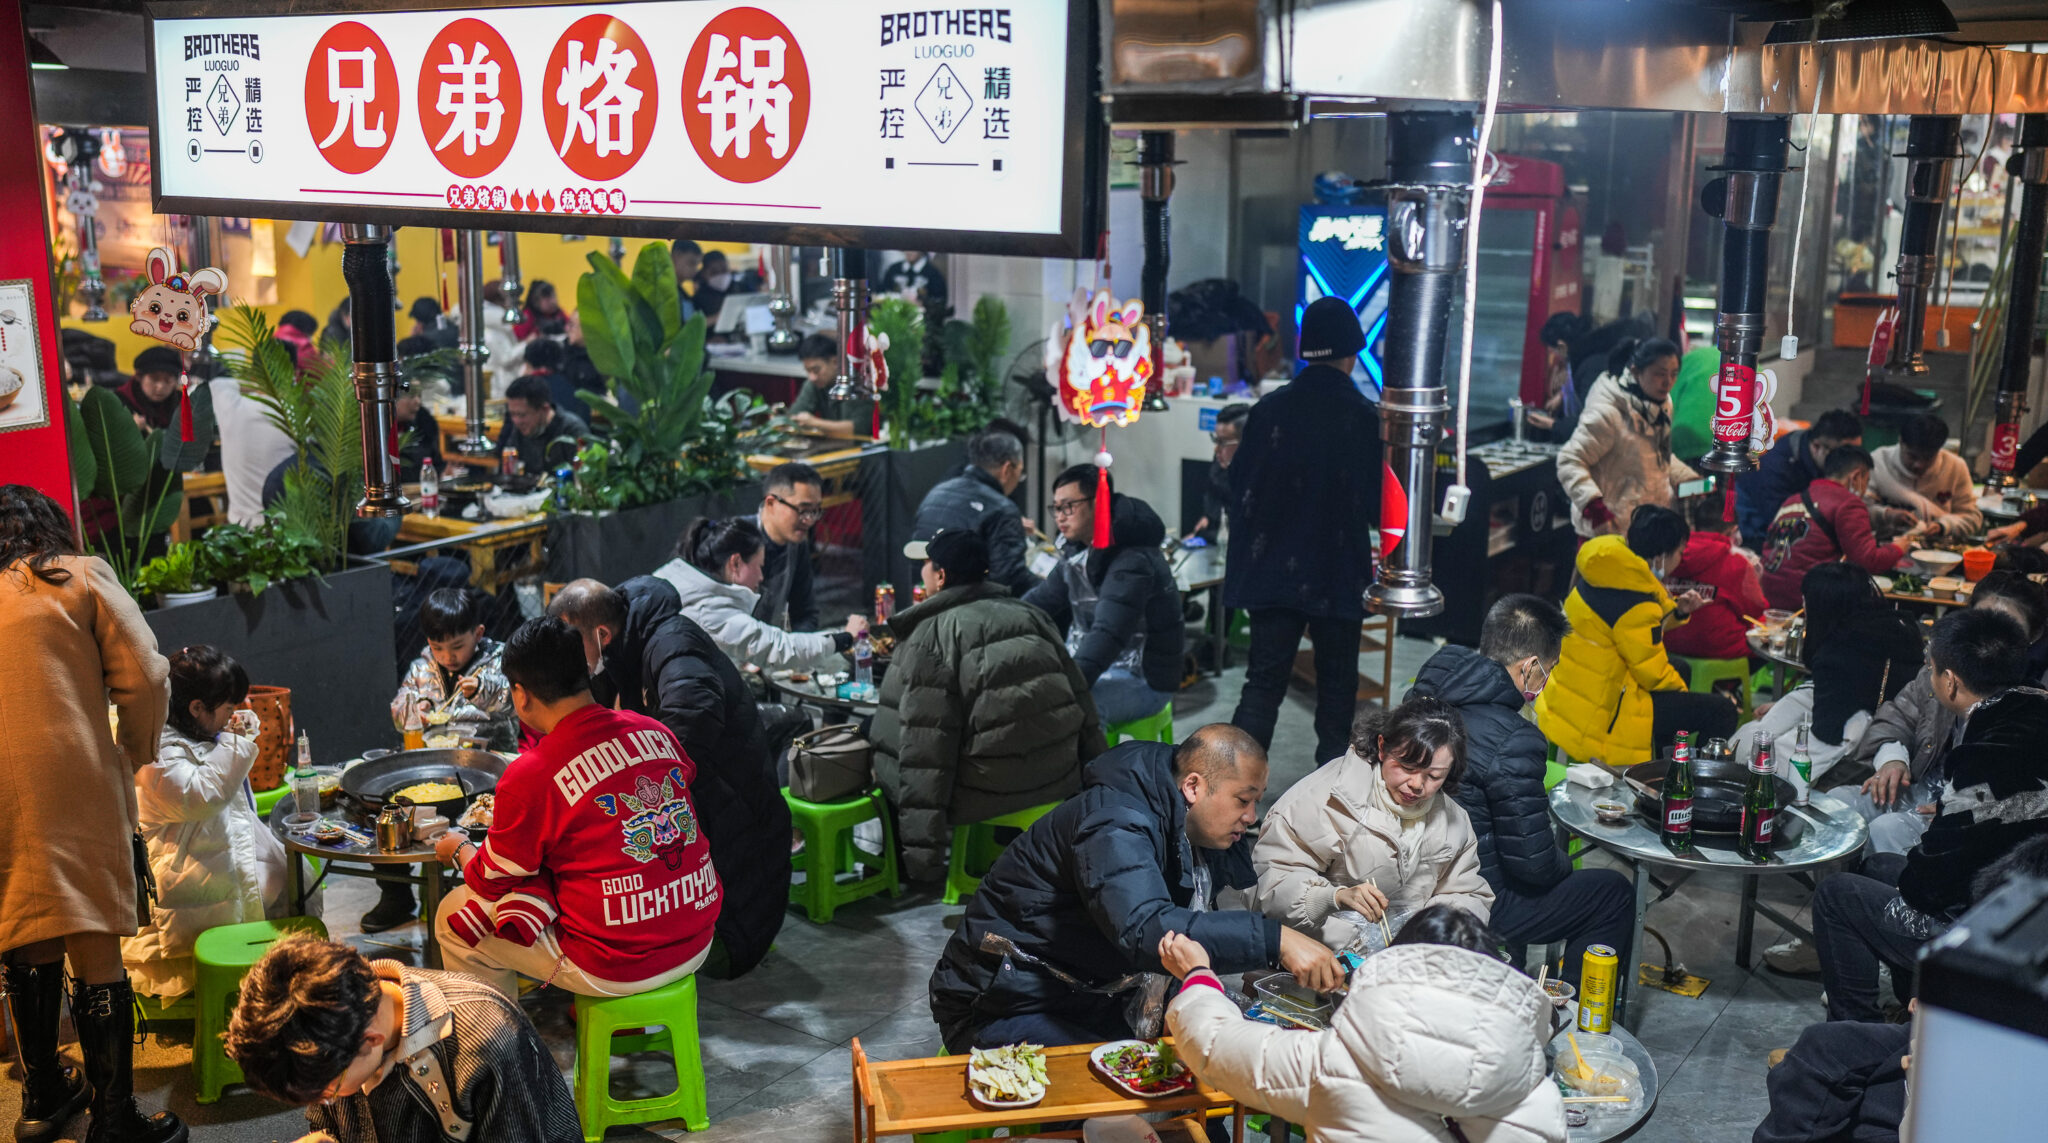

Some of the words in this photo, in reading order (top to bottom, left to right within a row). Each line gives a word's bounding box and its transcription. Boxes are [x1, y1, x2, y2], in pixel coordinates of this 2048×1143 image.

[184, 33, 261, 61] BROTHERS
[880, 9, 1012, 47] BROTHERS
[204, 60, 240, 72] LUOGUO
[914, 44, 975, 59] LUOGUO
[185, 77, 203, 132] 严控
[217, 84, 229, 127] 兄弟
[244, 77, 262, 133] 精选
[318, 34, 793, 160] 兄弟烙锅
[880, 69, 905, 138] 严控
[983, 67, 1011, 139] 精选
[449, 187, 505, 208] 兄弟烙锅
[1718, 385, 1742, 417] 5
[1999, 436, 2016, 456] 3
[553, 729, 682, 808] GOODLUCK
[601, 874, 644, 895] GOOD
